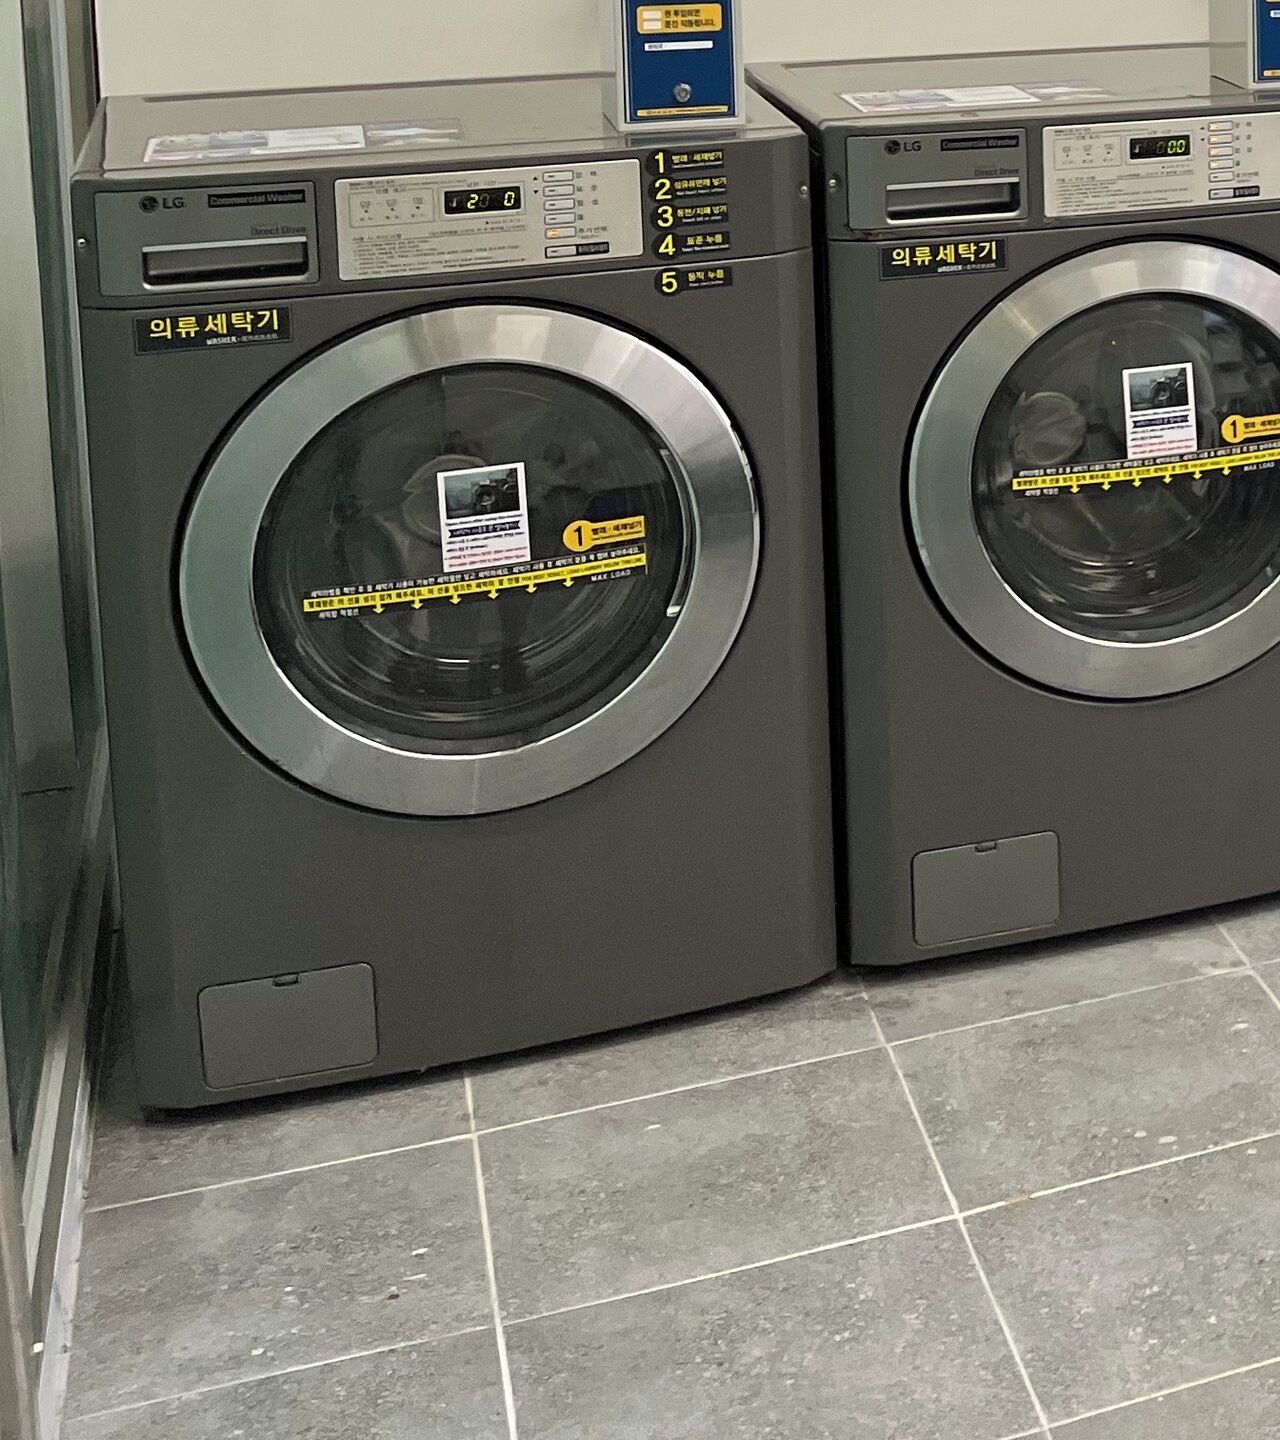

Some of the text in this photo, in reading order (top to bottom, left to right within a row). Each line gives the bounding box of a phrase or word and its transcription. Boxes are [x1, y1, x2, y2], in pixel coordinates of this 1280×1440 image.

[904, 141, 921, 151] LG
[655, 152, 664, 173] 1
[655, 178, 672, 200] 2
[163, 192, 304, 209] LG Commercial Washer
[657, 205, 673, 227] 3
[281, 225, 306, 234] Drive
[658, 234, 676, 255] 4
[662, 271, 678, 292] 5
[1230, 420, 1237, 438] 1
[574, 525, 583, 547] 1
